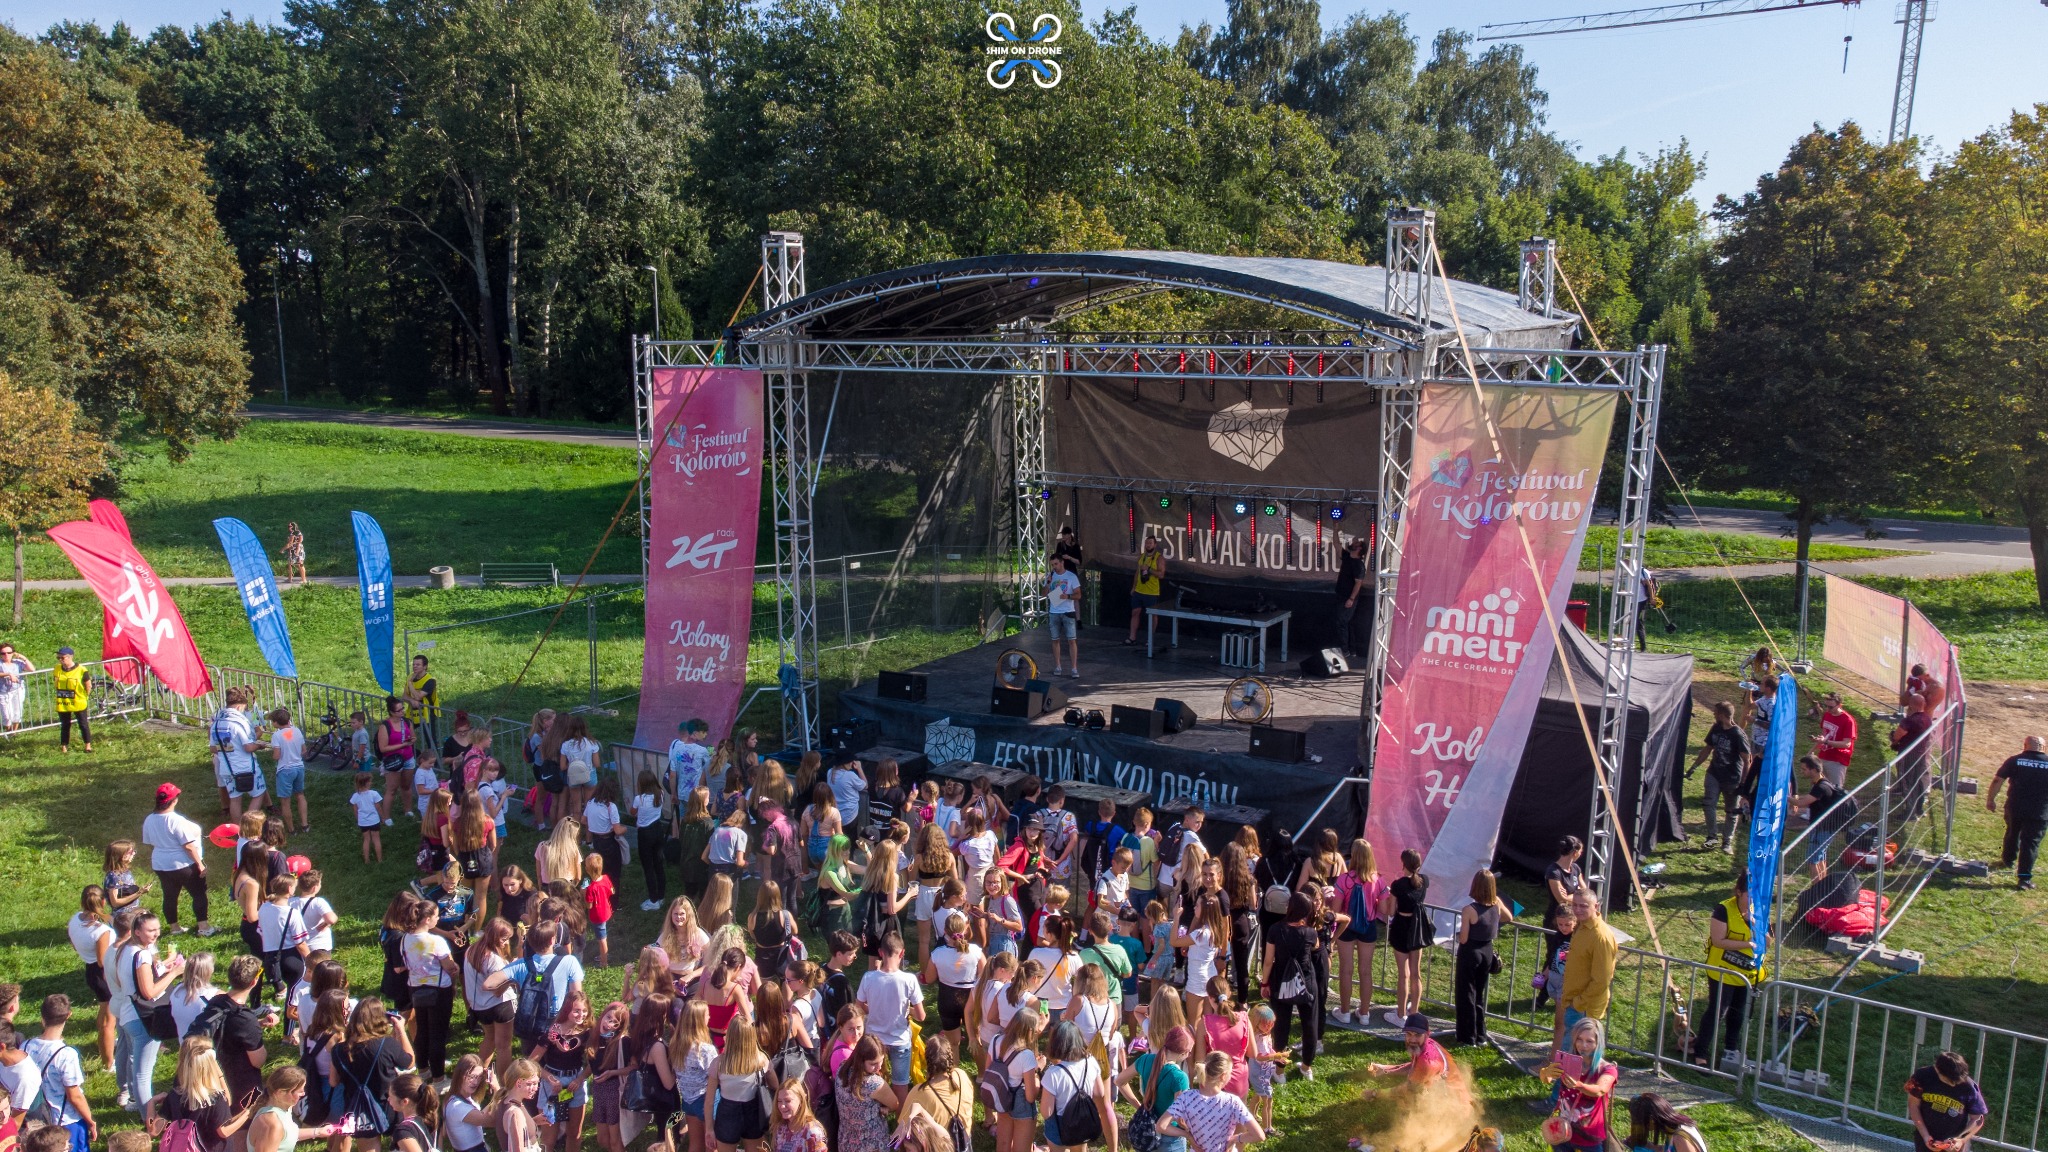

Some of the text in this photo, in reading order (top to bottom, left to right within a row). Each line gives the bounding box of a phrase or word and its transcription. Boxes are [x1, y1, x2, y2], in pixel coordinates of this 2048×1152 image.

[691, 427, 751, 454] Festiwal
[669, 448, 747, 478] Kolorów
[1475, 468, 1590, 497] Festiwal
[1432, 492, 1581, 530] Kolorów
[665, 532, 739, 570] ZET
[1256, 531, 1371, 573] KOOR
[1425, 599, 1519, 638] mini
[668, 619, 731, 661] Kolory
[676, 653, 717, 683] Holi
[1421, 657, 1440, 666] THE
[1444, 660, 1460, 669] ICE
[1463, 663, 1497, 674] CREAM
